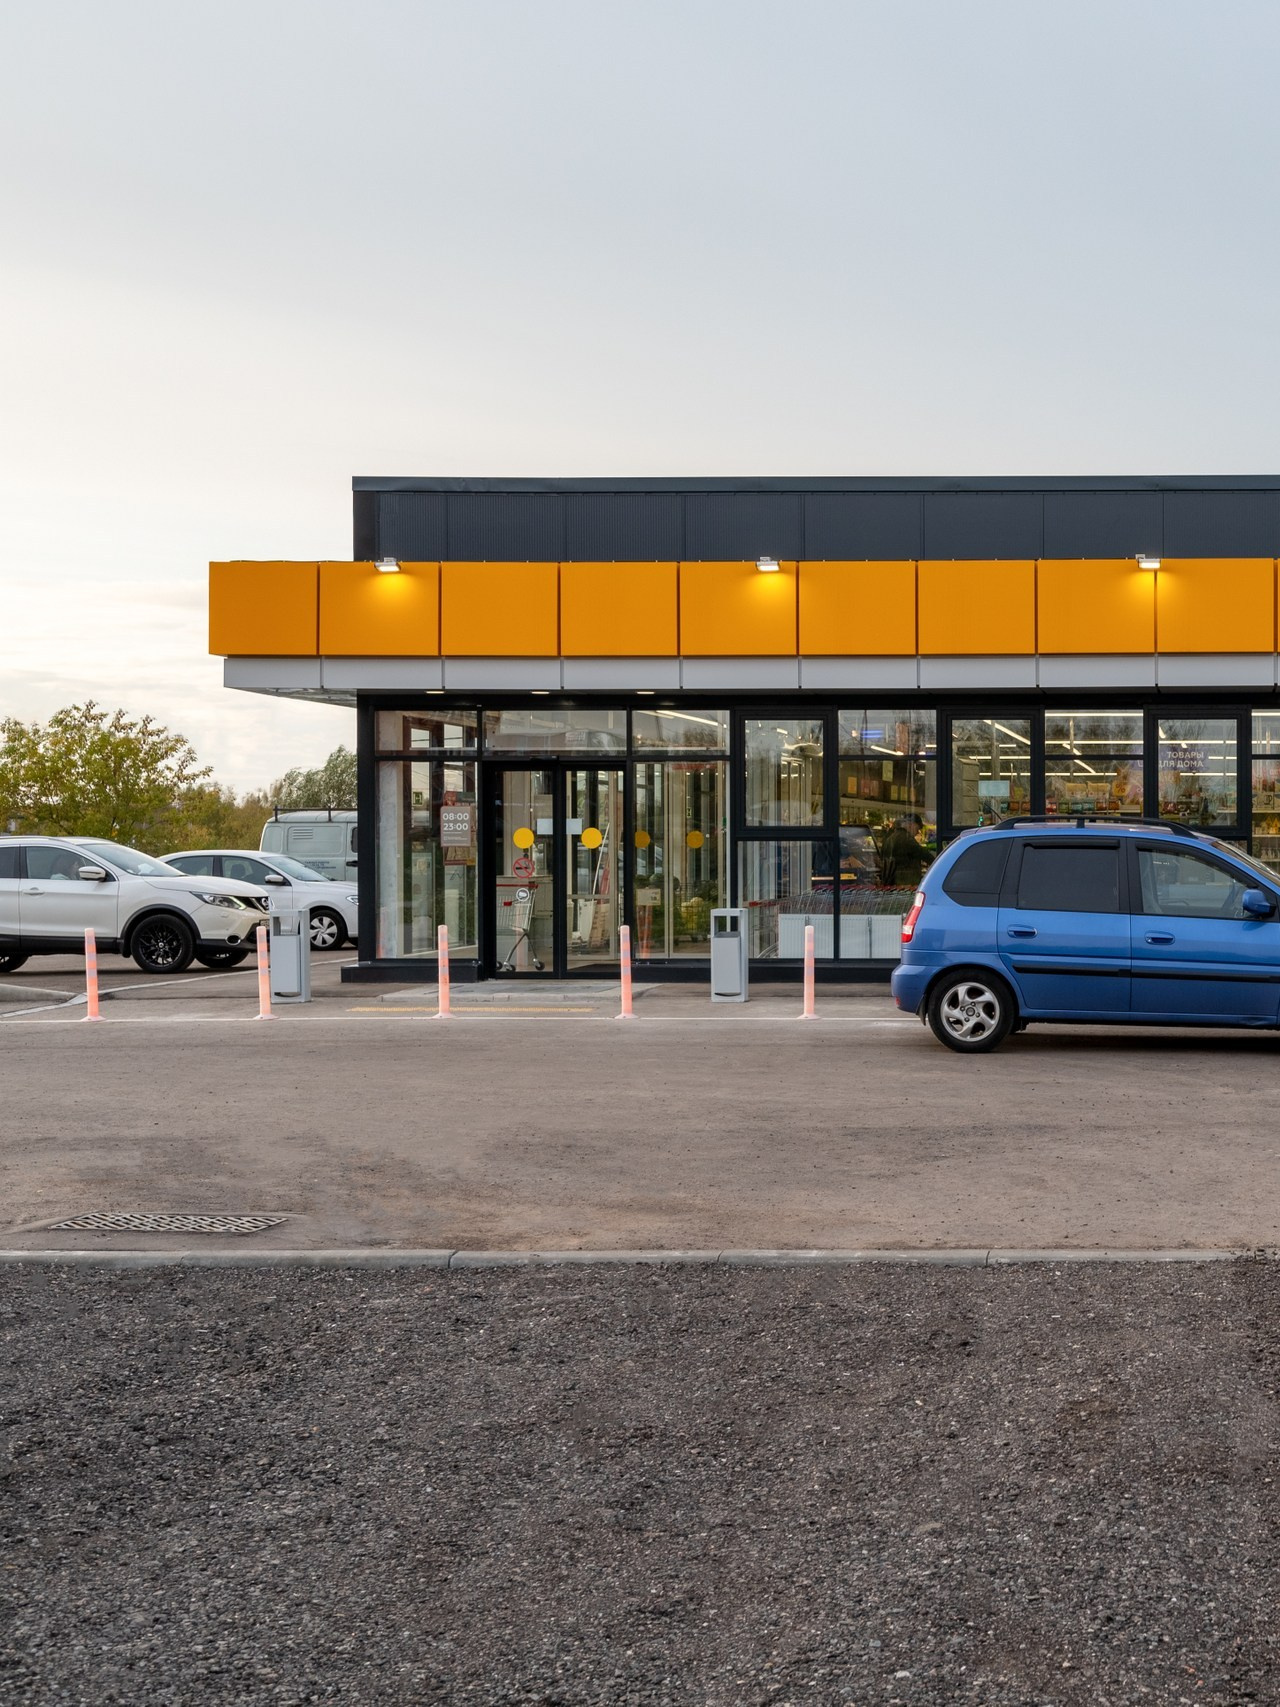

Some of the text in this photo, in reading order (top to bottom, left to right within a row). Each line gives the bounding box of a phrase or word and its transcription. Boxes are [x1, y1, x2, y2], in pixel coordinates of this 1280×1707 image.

[1166, 751, 1204, 759] ТОВАРЫ
[1176, 760, 1204, 768] ДОМА
[443, 812, 469, 821] 08:00
[443, 822, 469, 831] 23:00
